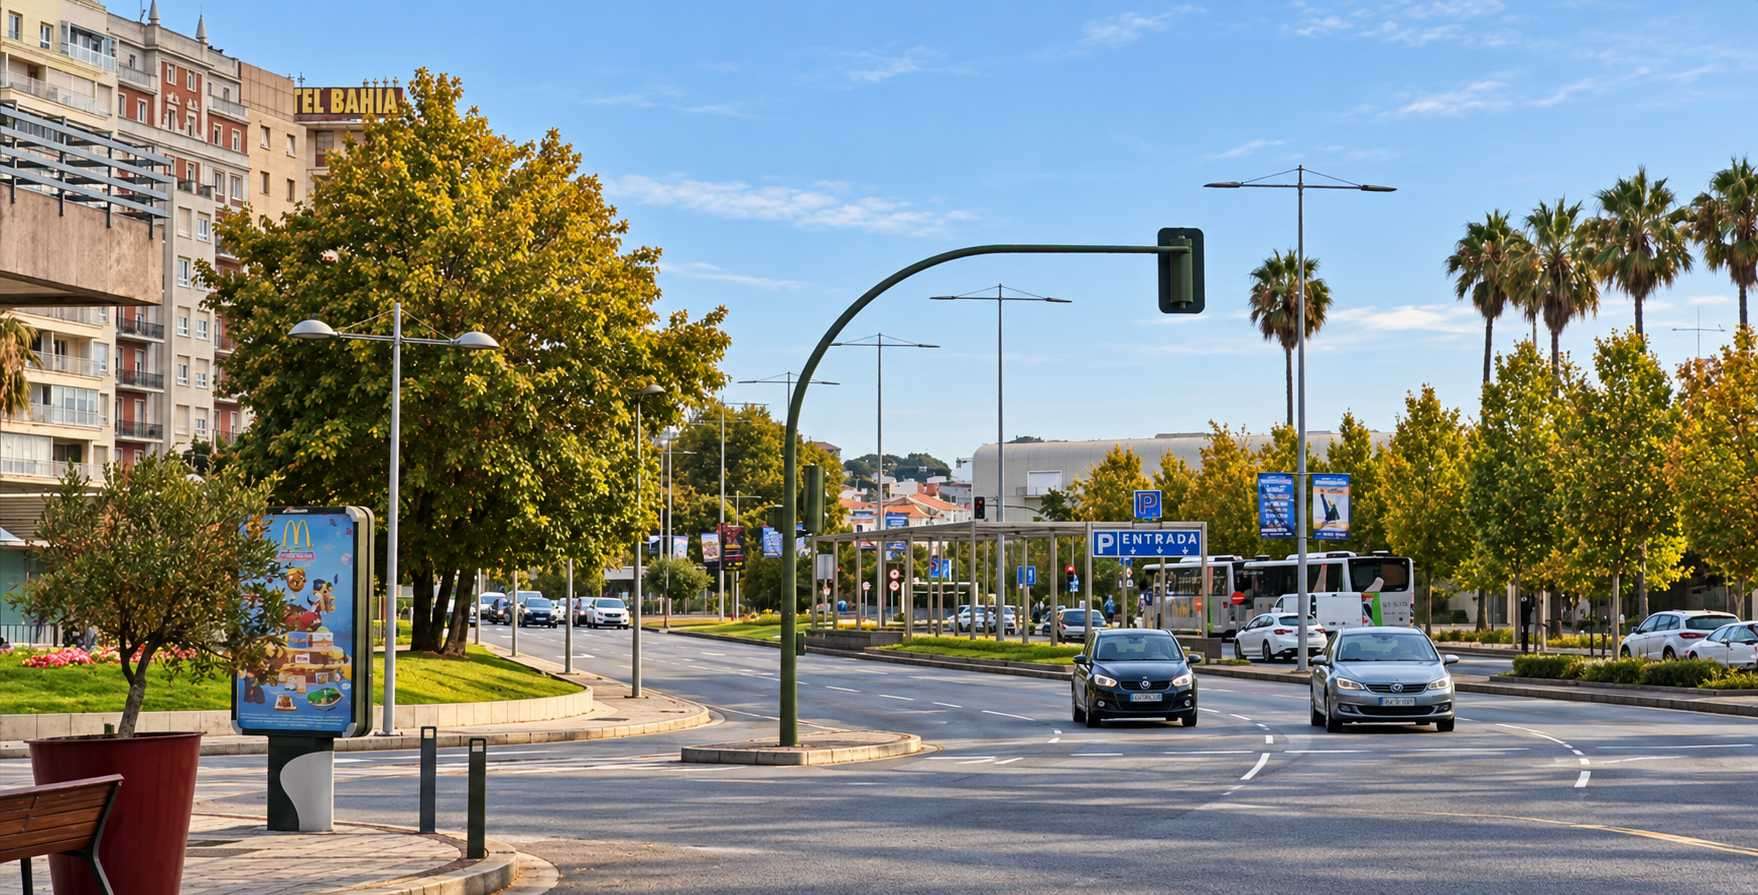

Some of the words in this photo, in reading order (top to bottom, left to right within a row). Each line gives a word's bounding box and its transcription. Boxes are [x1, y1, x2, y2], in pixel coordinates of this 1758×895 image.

[331, 88, 398, 113] BAHIA
[1137, 492, 1158, 515] P
[1097, 533, 1114, 555] P
[1122, 533, 1197, 545] ENTRADA
